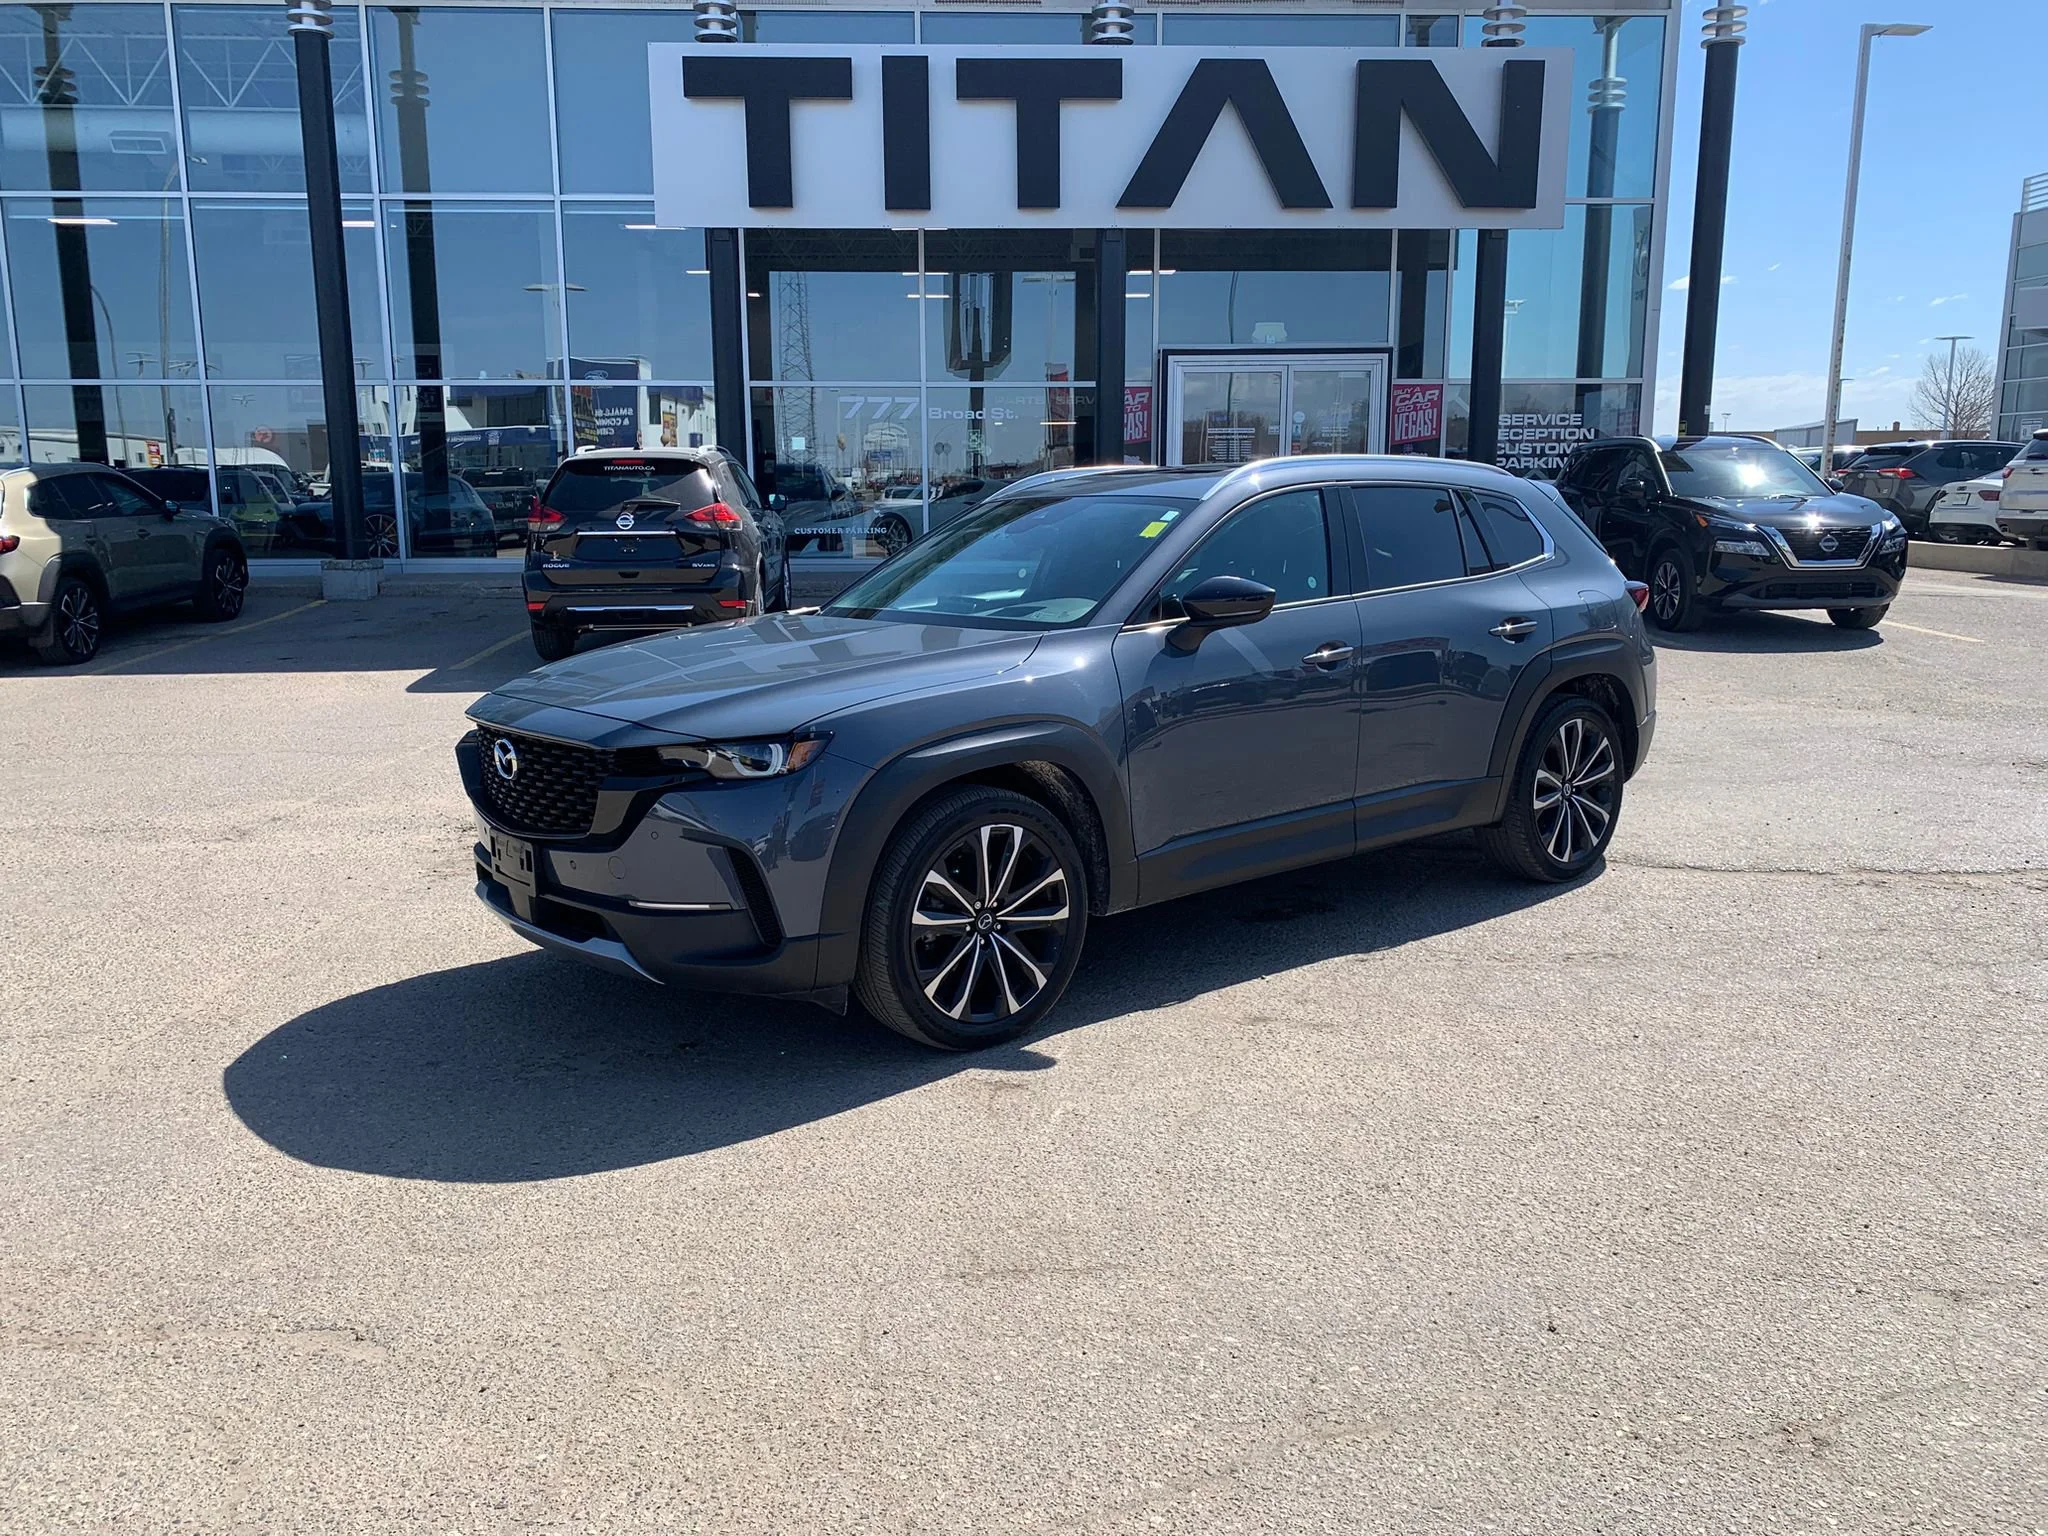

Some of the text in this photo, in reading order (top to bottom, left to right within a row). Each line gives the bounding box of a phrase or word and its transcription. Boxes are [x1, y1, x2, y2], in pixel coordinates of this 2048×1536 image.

[682, 55, 1547, 212] TITAN
[1393, 388, 1413, 396] BUY
[1395, 390, 1440, 406] CAR
[1055, 395, 1095, 405] SERV
[1124, 392, 1149, 406] AR
[839, 396, 920, 420] 777
[929, 407, 1019, 421] Broad St.
[1125, 404, 1141, 412] TO
[1396, 402, 1431, 413] GO TO
[1124, 411, 1148, 441] AS!
[1394, 408, 1437, 440] VEGAS!
[1498, 413, 1582, 426] SERVICE
[1497, 428, 1595, 440] ECEPTION
[1496, 442, 1578, 455] CUSTOM
[1496, 457, 1569, 468] PARKIN
[794, 527, 844, 535] CUSTOMER
